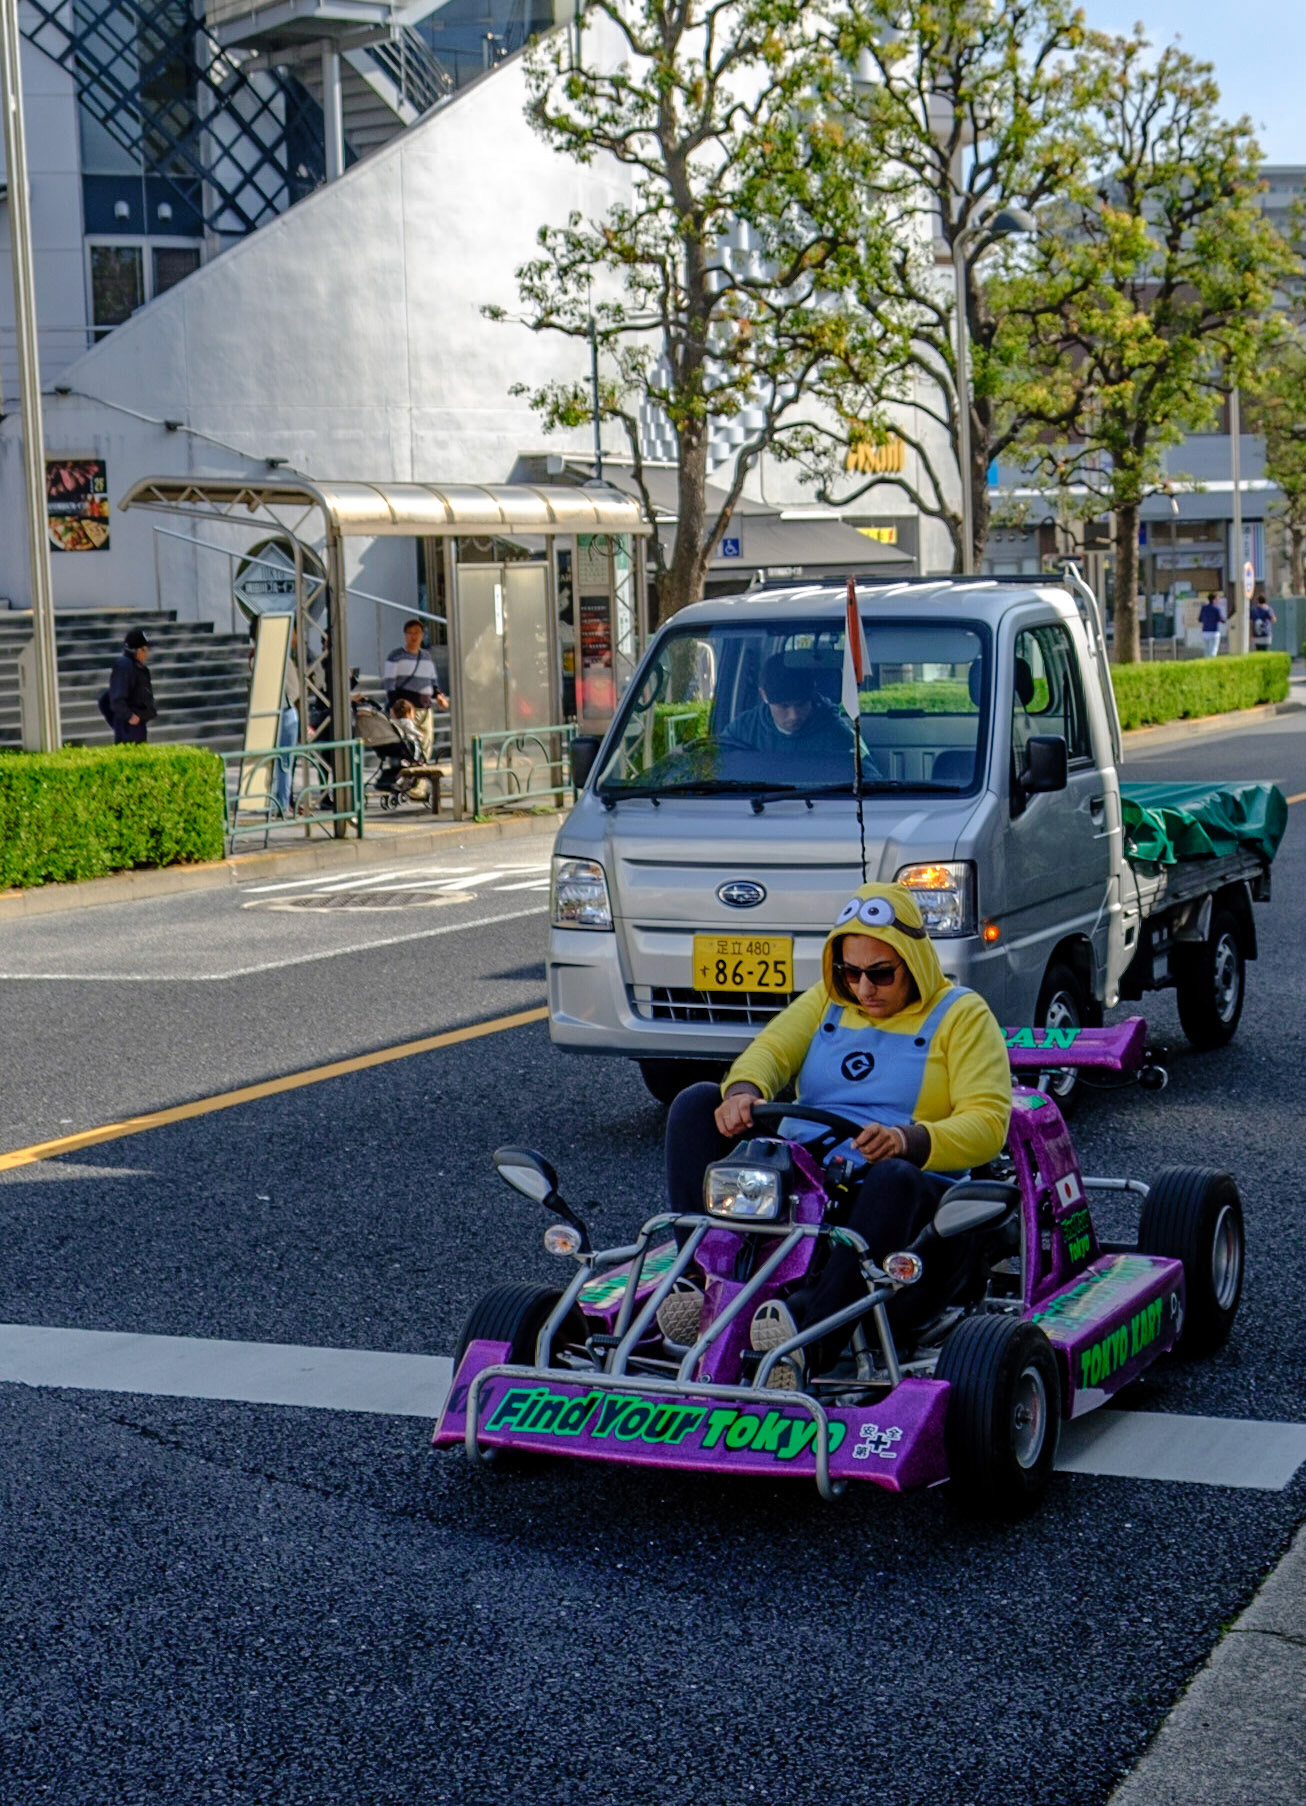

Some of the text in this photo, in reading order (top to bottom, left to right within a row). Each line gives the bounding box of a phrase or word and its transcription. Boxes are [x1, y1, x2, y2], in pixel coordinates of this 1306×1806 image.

[716, 940, 770, 956] 足立 480
[715, 959, 787, 987] 86-25
[1001, 1027, 1082, 1049] AN
[1081, 1324, 1129, 1390] TOKYO
[1131, 1297, 1163, 1358] KART
